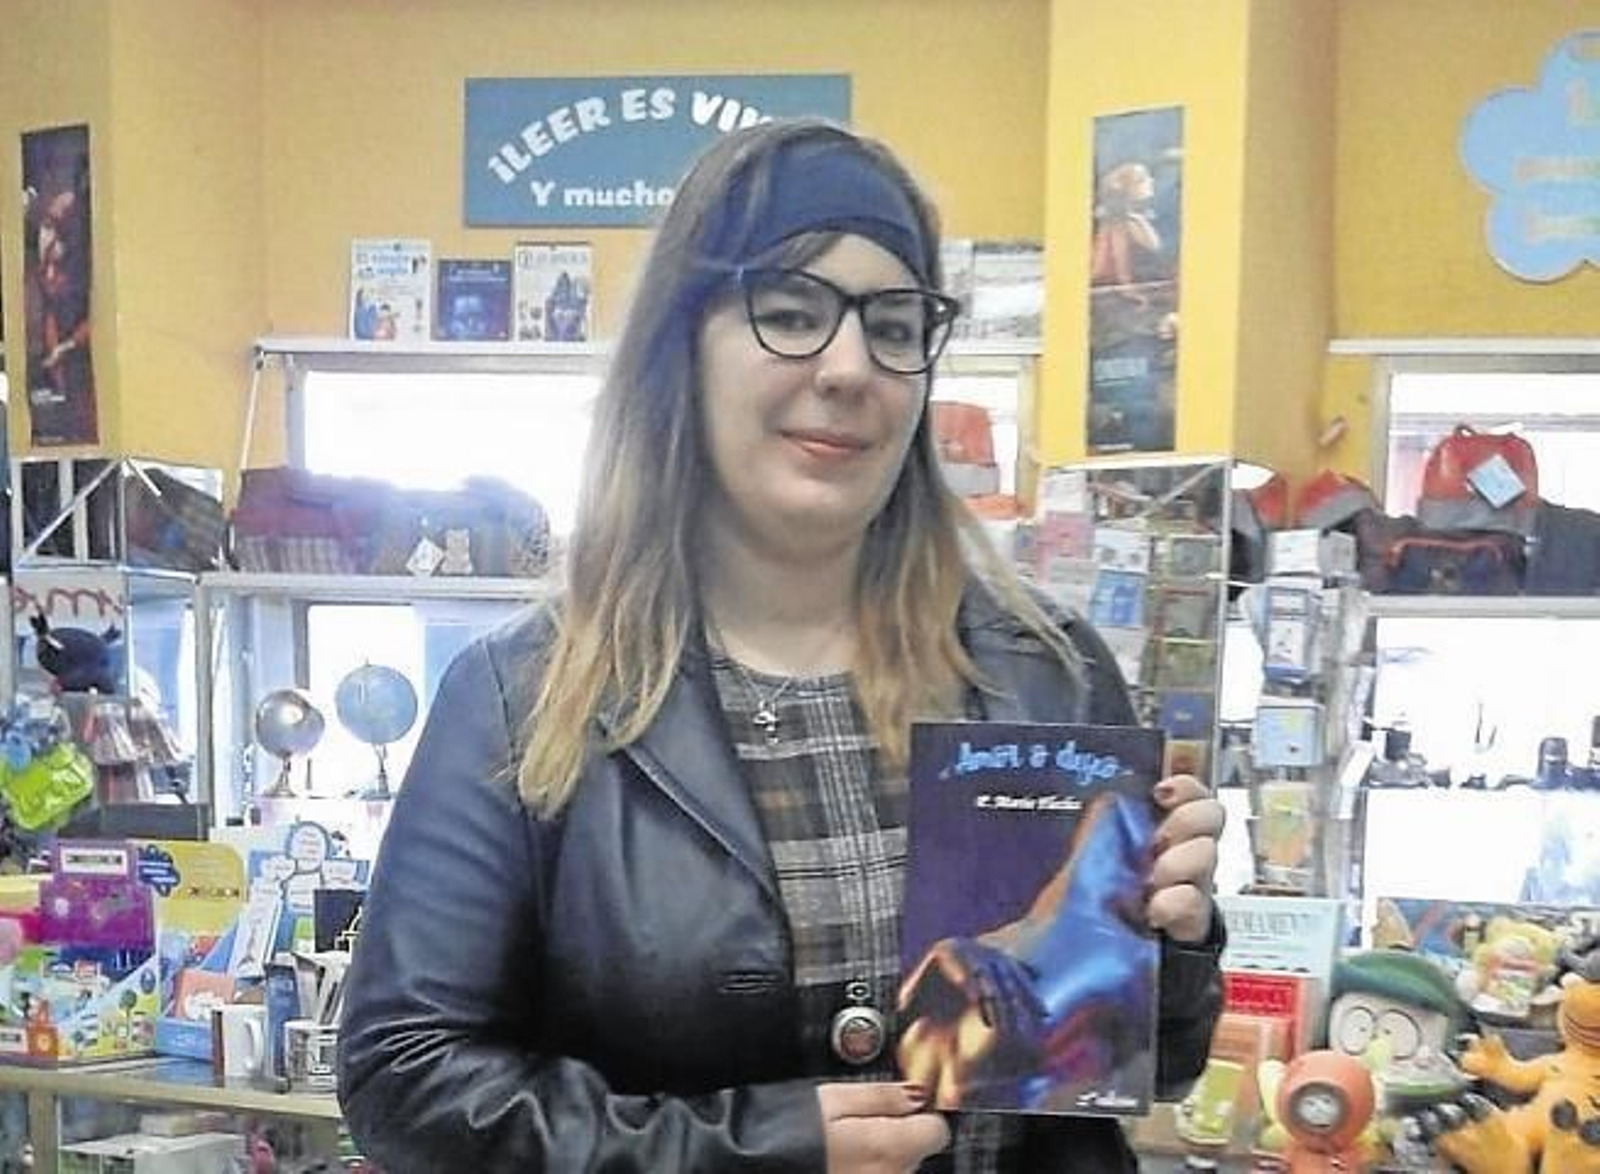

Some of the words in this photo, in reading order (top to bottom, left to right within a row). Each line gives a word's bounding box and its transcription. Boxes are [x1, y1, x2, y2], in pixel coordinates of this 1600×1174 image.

[488, 97, 611, 183] ¡LEER
[621, 88, 676, 121] ES
[530, 180, 555, 206] Y
